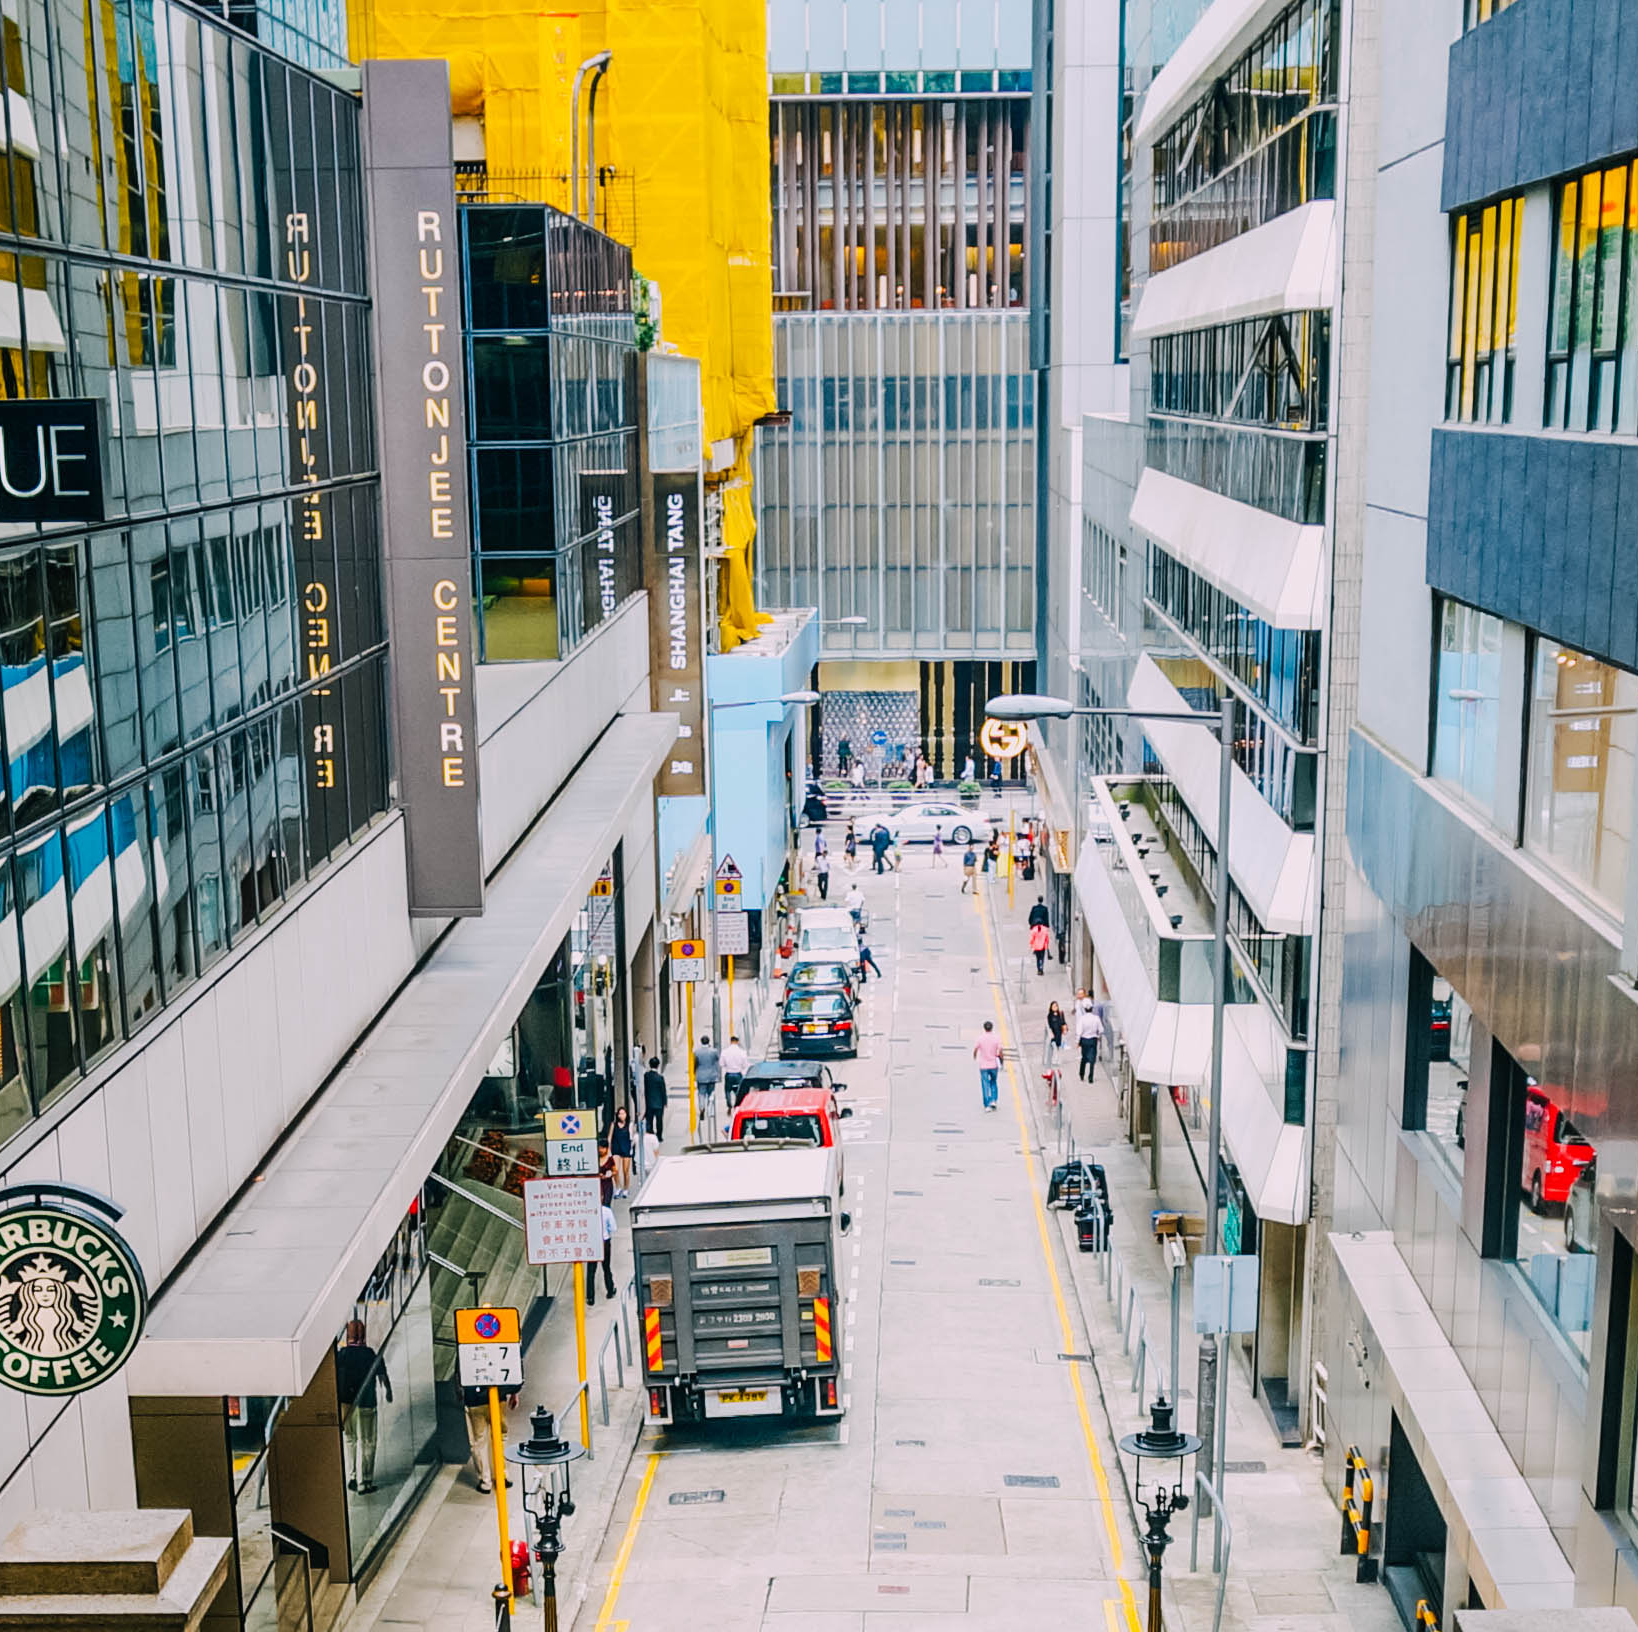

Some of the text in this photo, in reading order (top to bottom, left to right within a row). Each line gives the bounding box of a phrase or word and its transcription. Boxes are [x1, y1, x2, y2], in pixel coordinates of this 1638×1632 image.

[417, 210, 465, 788] RUTTONJEE CENTRE
[666, 493, 685, 553] TANG
[668, 556, 688, 671] SHANGHAI
[561, 1143, 584, 1153] End
[499, 1346, 508, 1360] 7
[500, 1368, 510, 1382] 7
